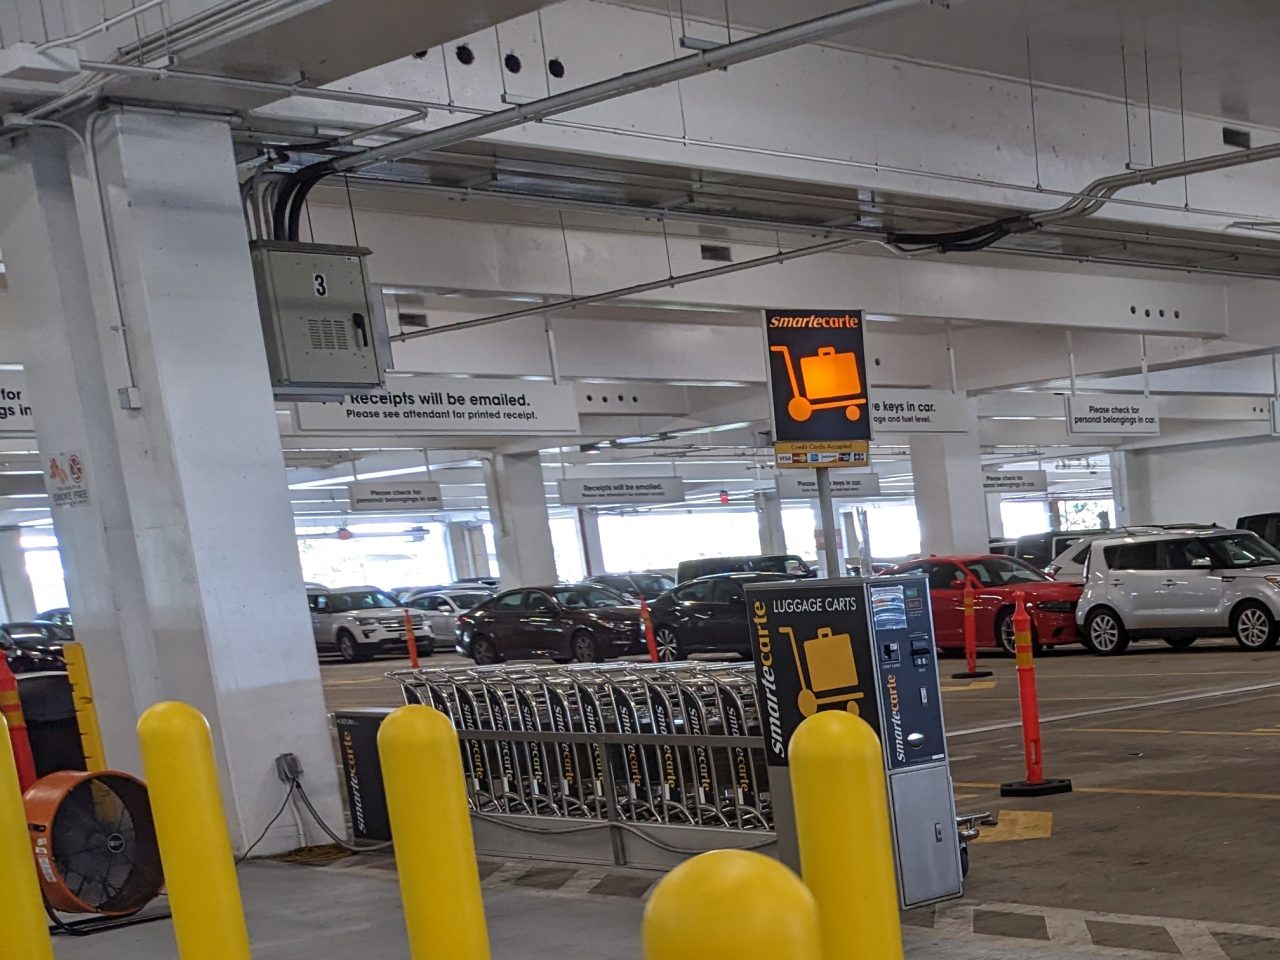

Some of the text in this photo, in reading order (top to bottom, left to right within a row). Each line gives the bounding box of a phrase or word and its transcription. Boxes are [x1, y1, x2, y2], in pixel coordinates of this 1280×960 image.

[315, 275, 326, 296] 3
[769, 315, 858, 328] smartecarte
[1, 388, 21, 400] for
[350, 392, 531, 408] Receipts will be emailed.
[19, 403, 32, 416] in
[883, 401, 904, 413] keys
[906, 401, 915, 411] in
[917, 403, 936, 412] car.
[1089, 405, 1140, 414] Please check for
[346, 409, 538, 421] Please see attendant for printed receipt.
[1074, 416, 1102, 424] personal
[1103, 416, 1137, 426] belongings
[1137, 416, 1144, 424] in
[773, 597, 857, 613] LUGGAGE CARTS
[753, 600, 785, 758] smartecarte
[887, 673, 906, 763] smartecarte
[344, 731, 367, 834] smartecarte
